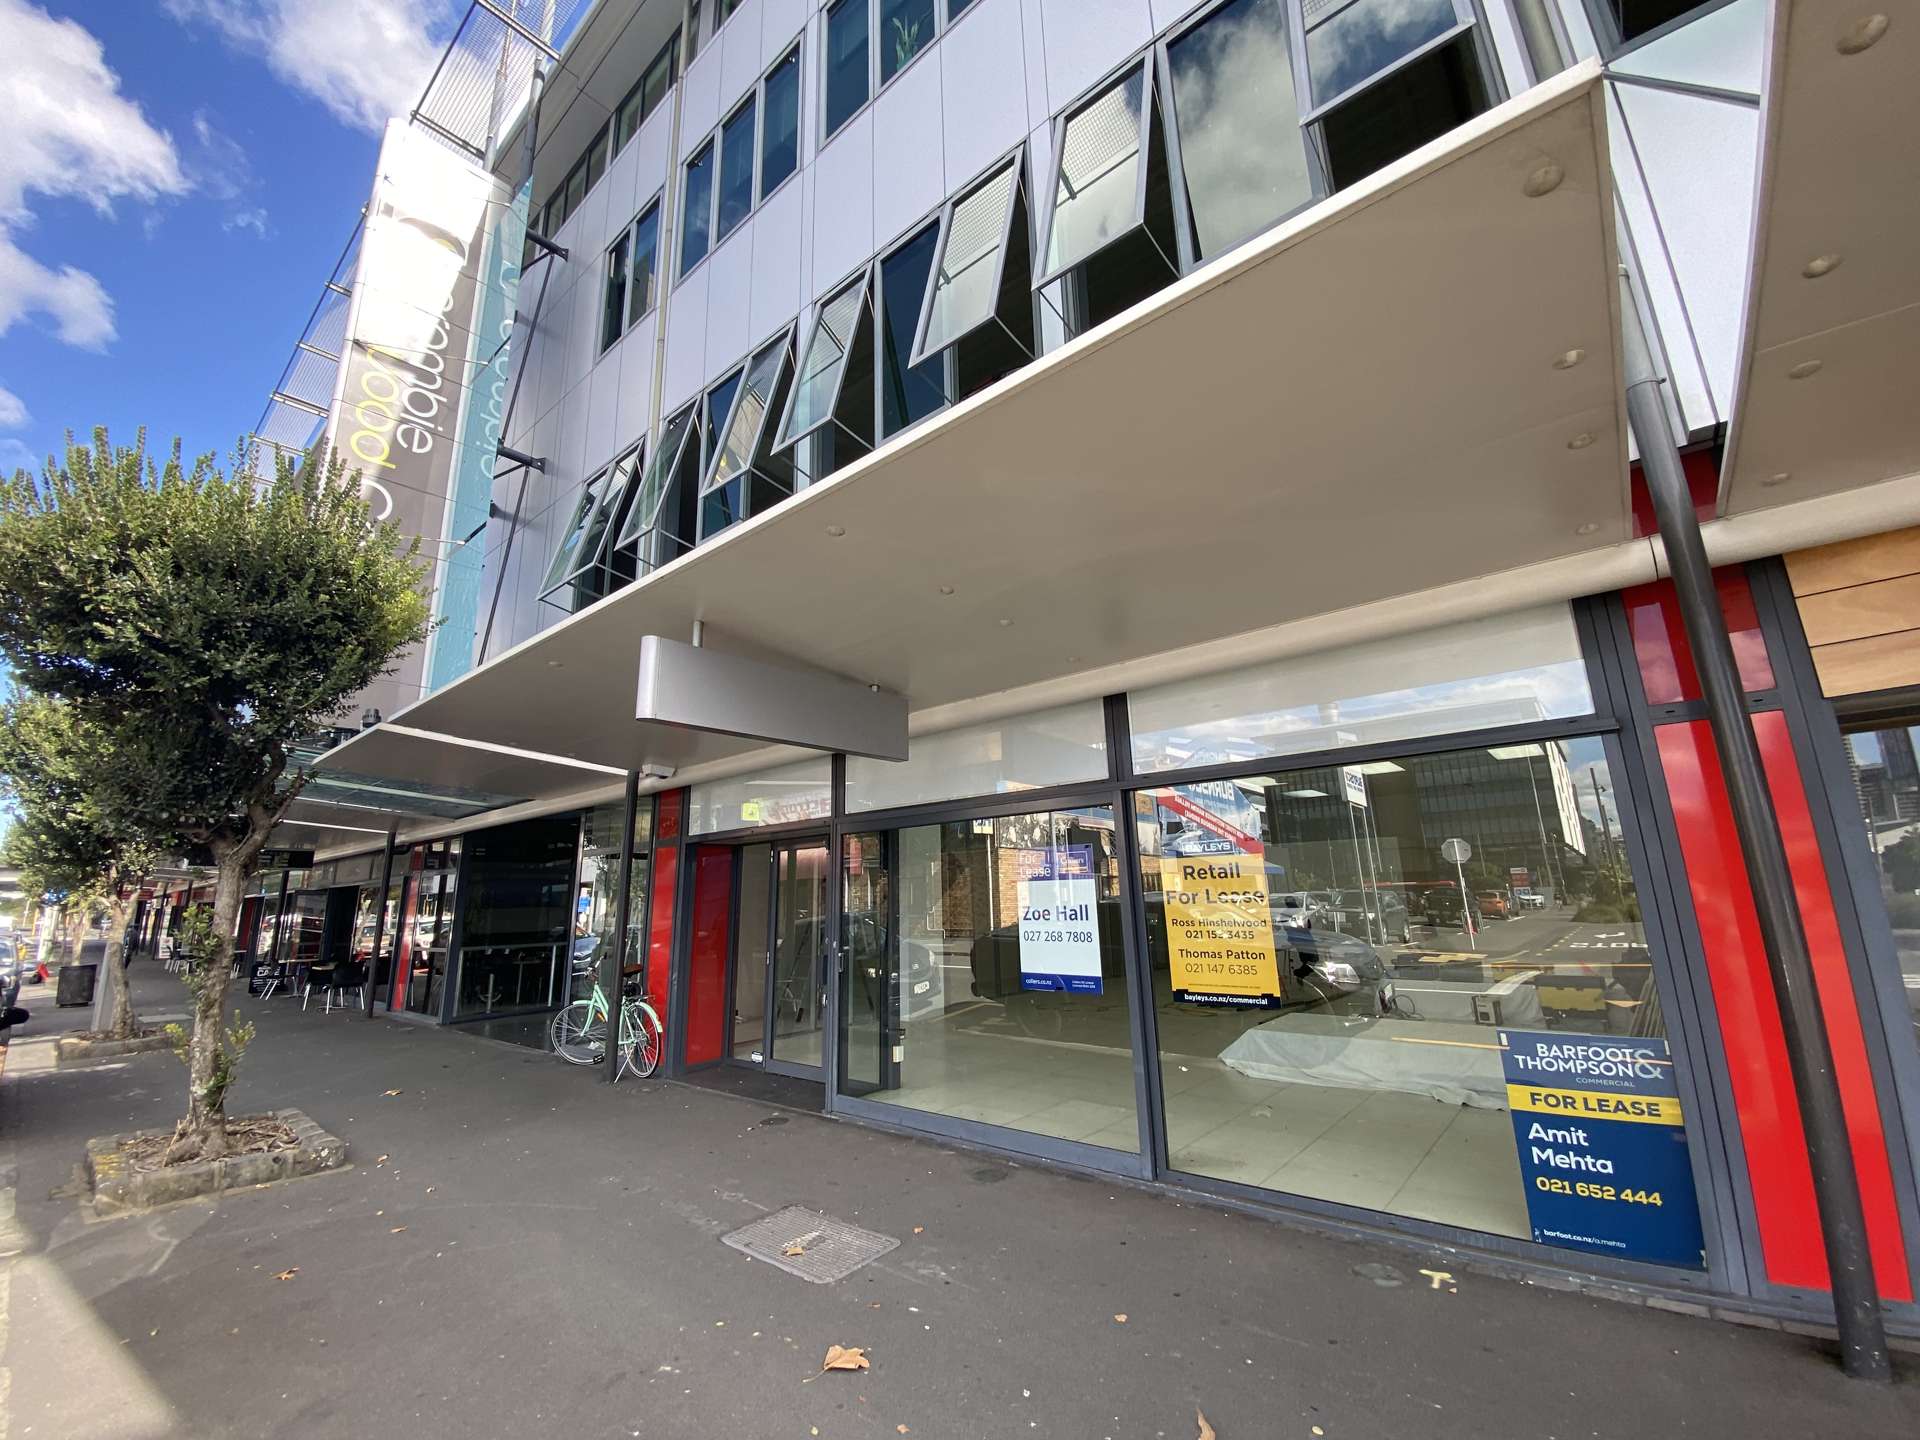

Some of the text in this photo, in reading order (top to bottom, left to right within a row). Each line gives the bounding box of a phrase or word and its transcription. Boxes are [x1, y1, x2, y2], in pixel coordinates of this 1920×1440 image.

[1185, 842, 1231, 853] BAYLEYS
[1021, 866, 1051, 878] Lease
[1183, 862, 1241, 880] Retail
[1166, 889, 1265, 904] For Lease
[1023, 904, 1089, 921] Zoe Hall
[1172, 918, 1267, 927] Ross Hinshelwood
[1023, 930, 1093, 943] 027 268 7808
[1185, 930, 1203, 939] 021
[1227, 930, 1255, 939] 3435
[1178, 948, 1266, 960] Thomas Patton
[1185, 963, 1258, 975] 021 147 6385
[1184, 993, 1268, 1005] bayleys.co.nz/commercial
[1536, 1043, 1634, 1063] BARFOOT
[1514, 1055, 1634, 1078] THOMPSON
[1575, 1077, 1636, 1088] COMMERCIAL
[1530, 1092, 1662, 1117] FOR LEASE
[1528, 1122, 1589, 1147] Amit
[1531, 1146, 1614, 1174] Mehta
[1536, 1176, 1663, 1207] 021 652 444
[1543, 1229, 1626, 1248] barfoot.co.nz/a.mehta
